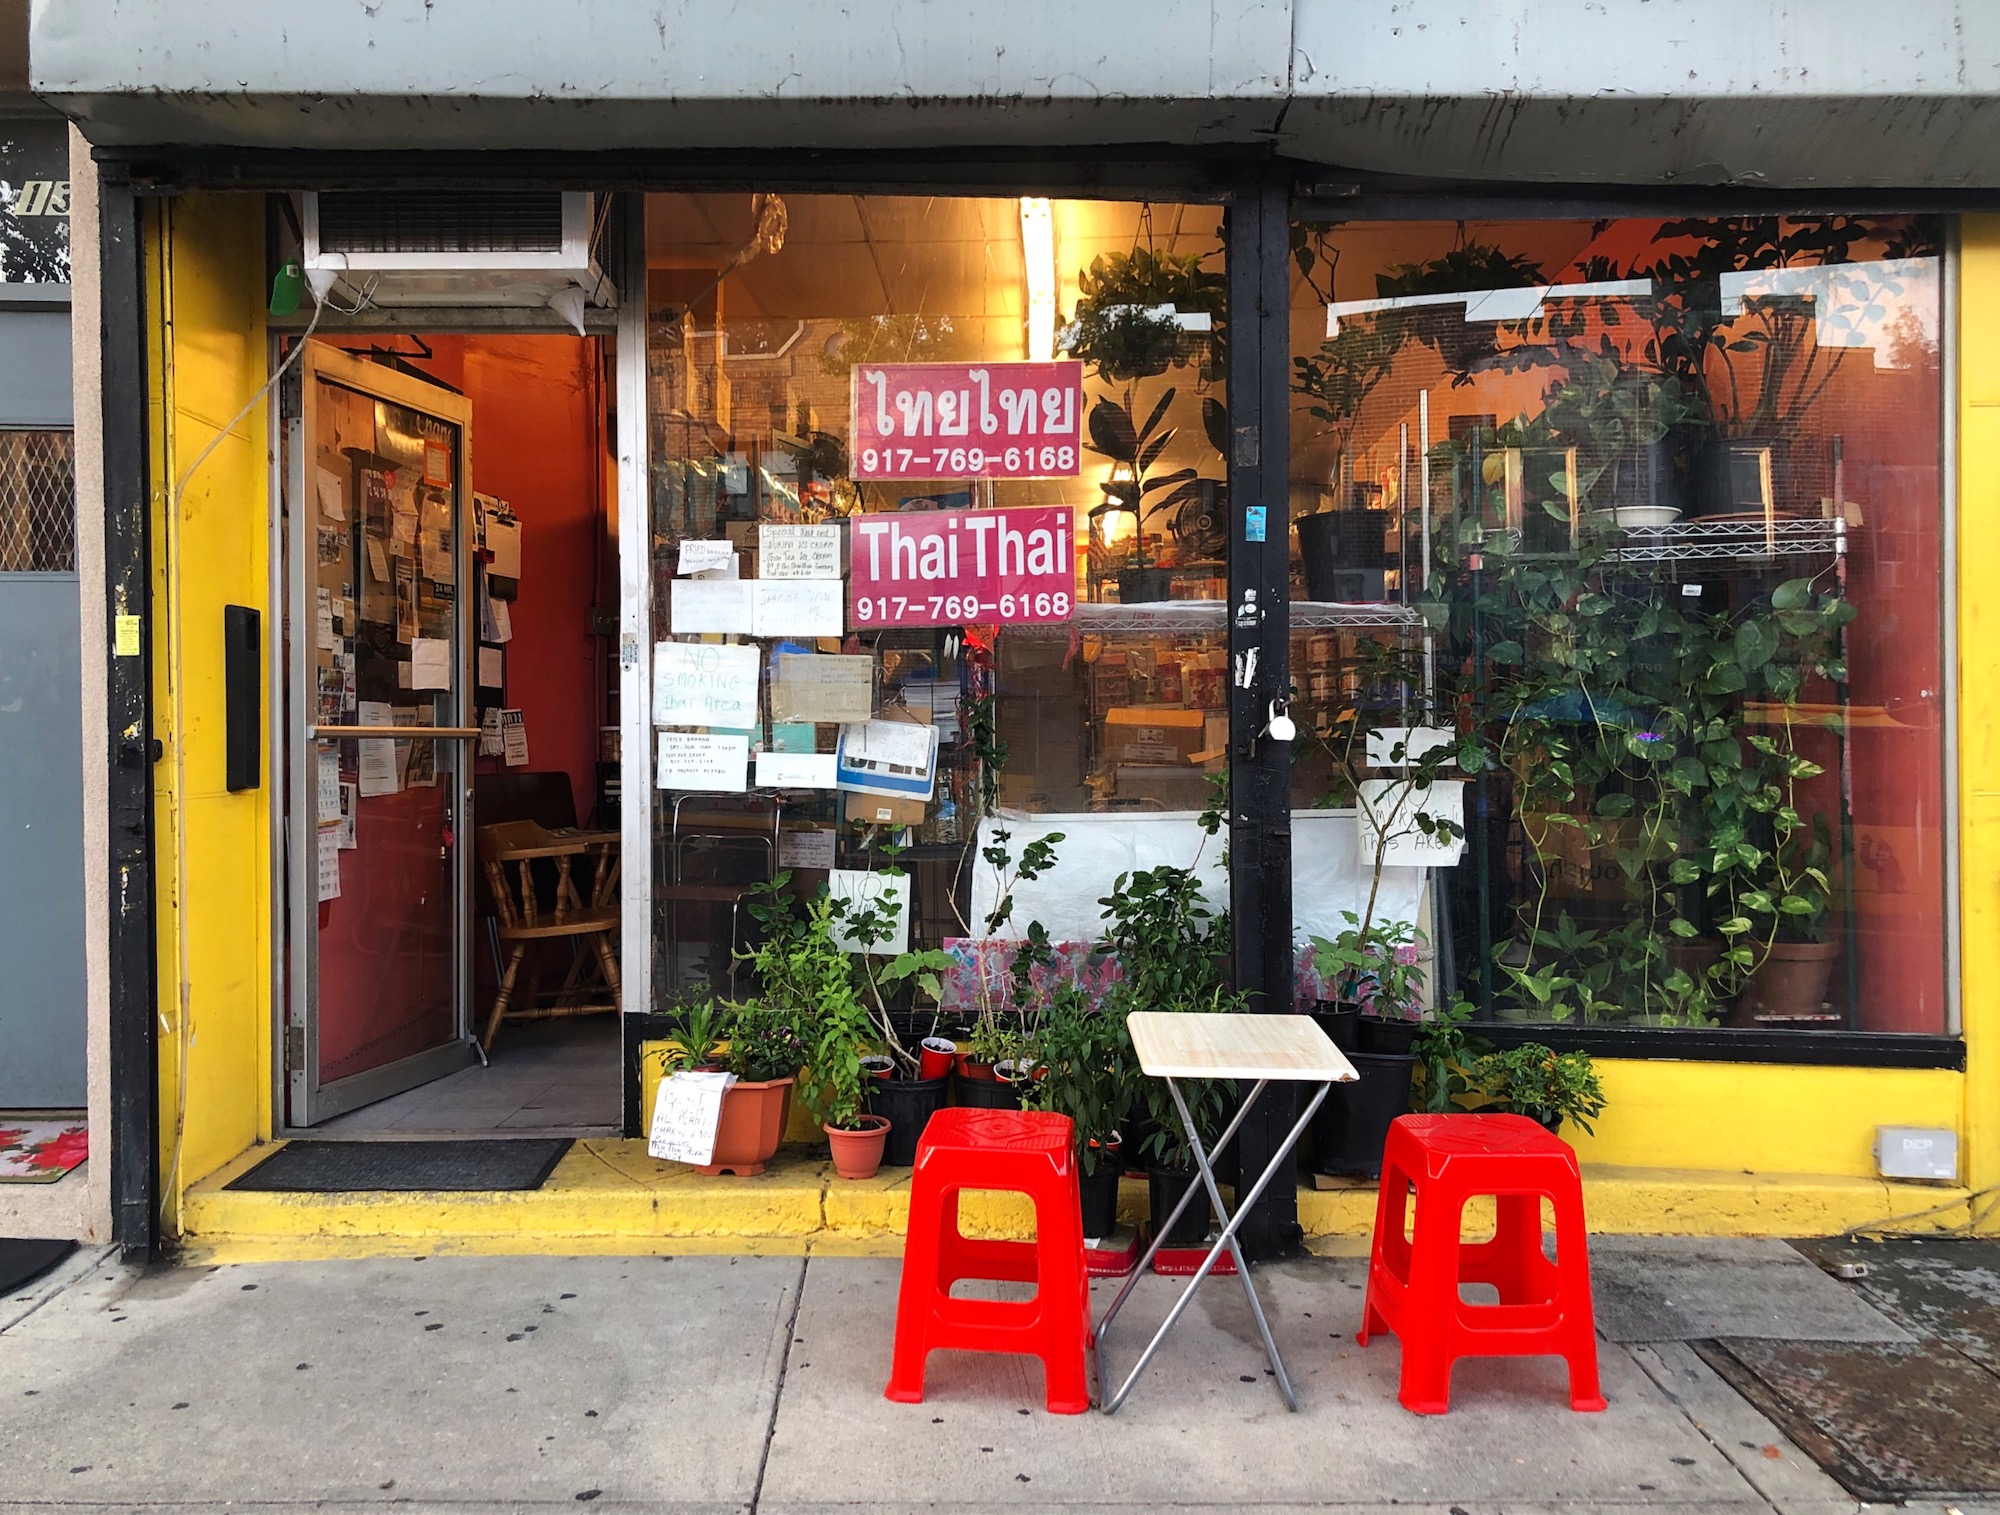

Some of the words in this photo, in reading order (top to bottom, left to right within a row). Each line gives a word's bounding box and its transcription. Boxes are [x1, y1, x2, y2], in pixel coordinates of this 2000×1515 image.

[865, 368, 1074, 437] ไทยไทย
[862, 446, 1074, 473] 917-769-6168
[859, 517, 958, 581] Thai
[965, 513, 1066, 577] Thai
[435, 583, 443, 593] 24
[857, 591, 1069, 620] 917-769-6168
[684, 646, 720, 673] NO
[663, 672, 742, 690] SMOKING
[704, 695, 742, 713] Area
